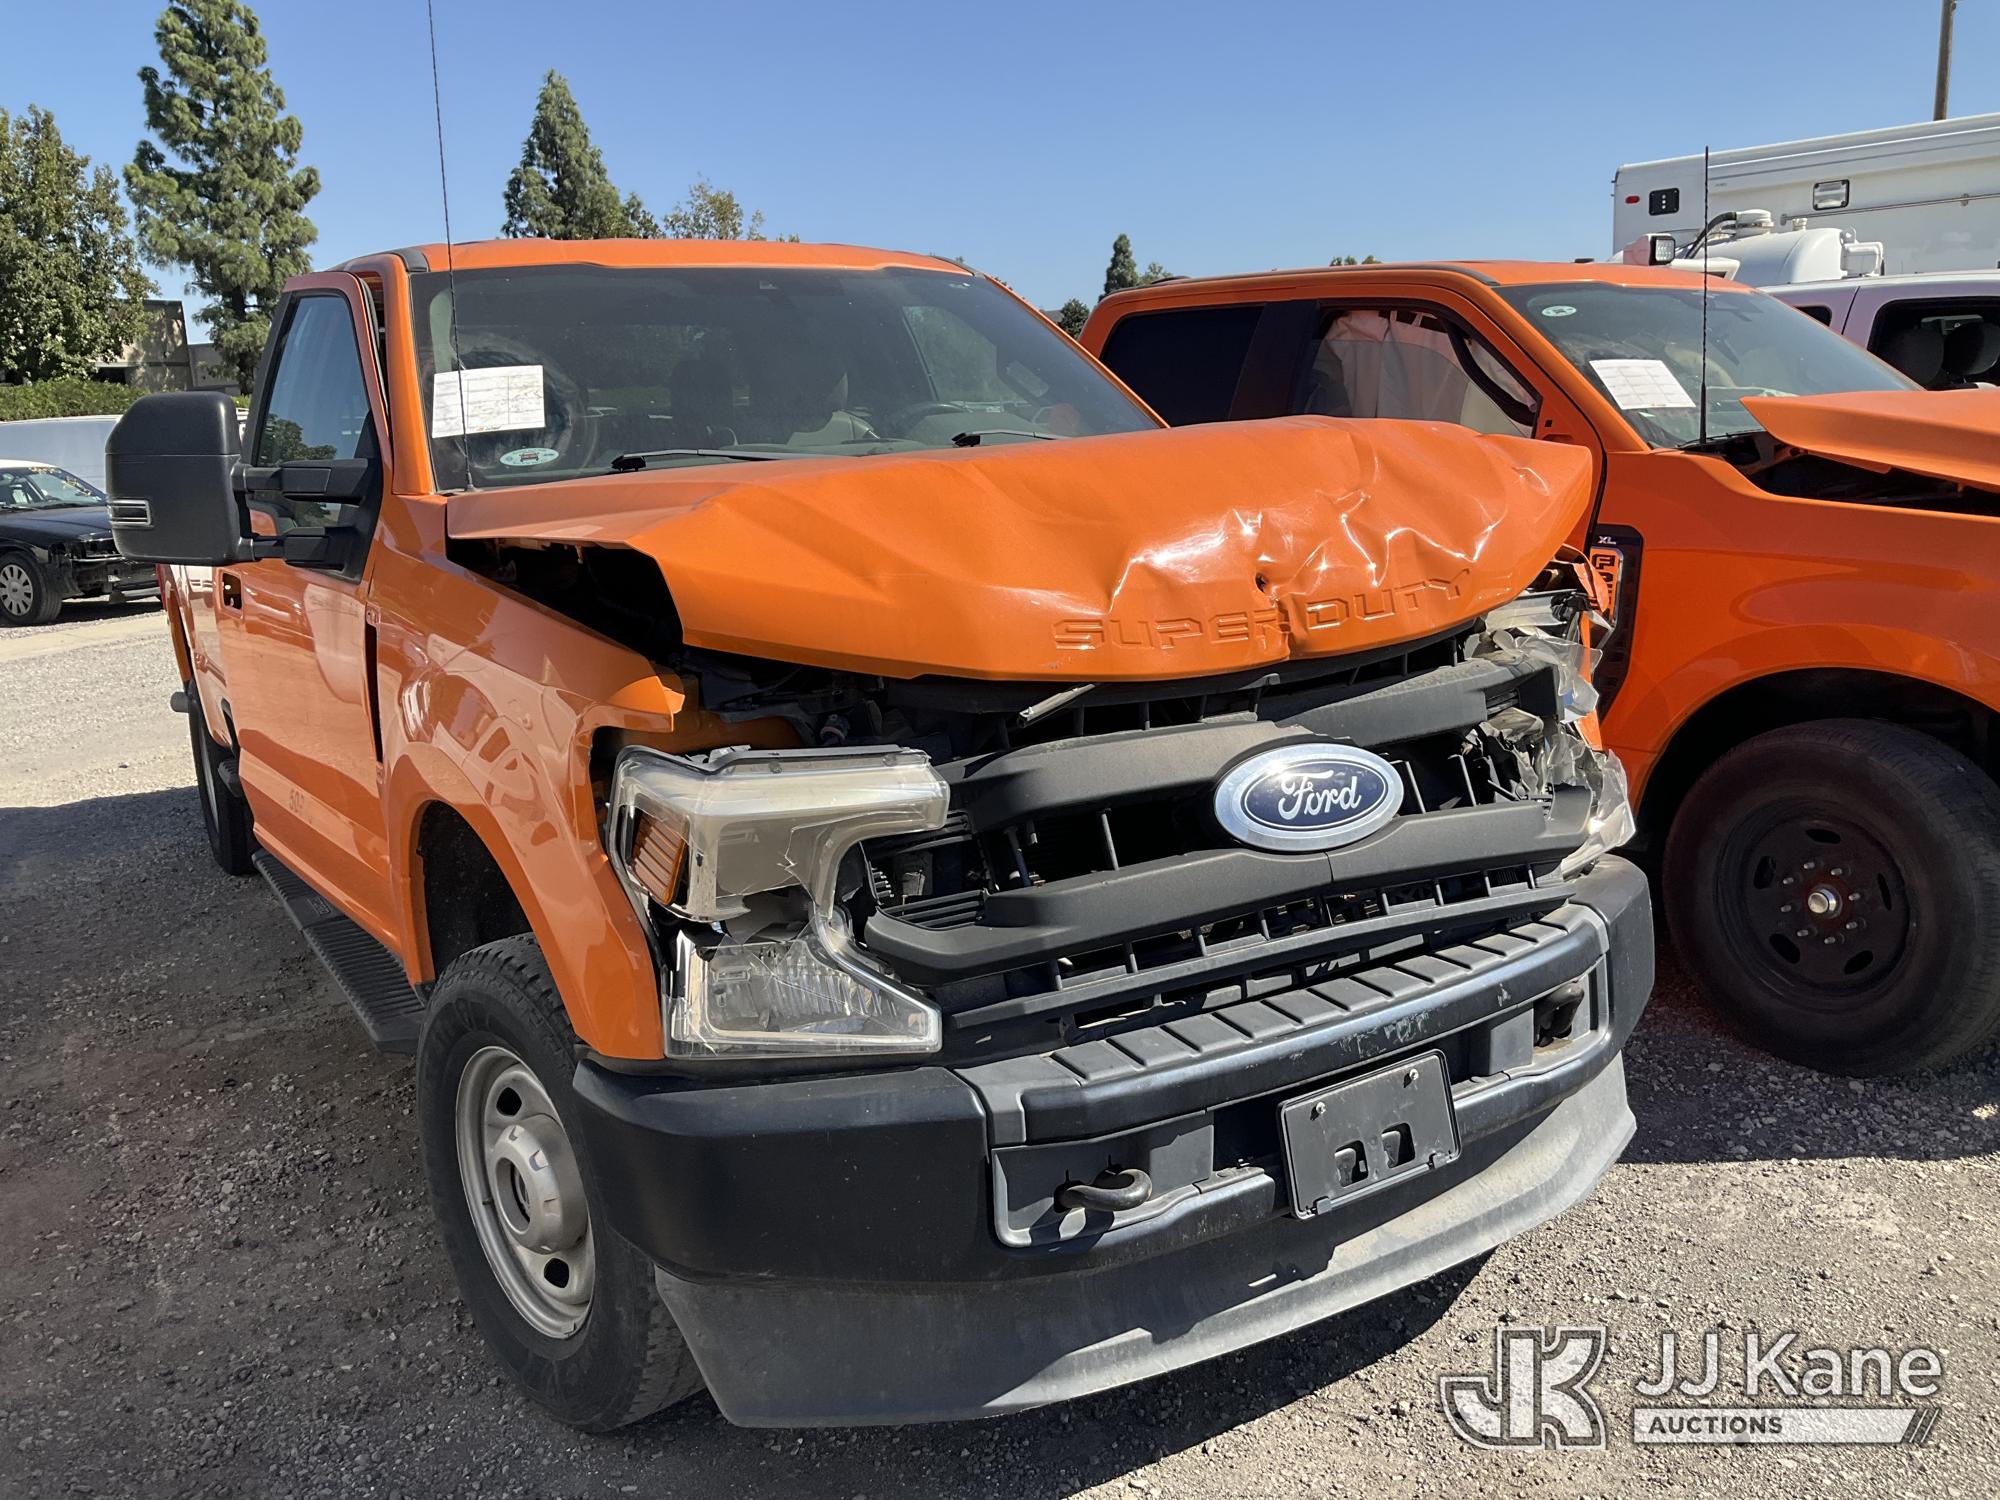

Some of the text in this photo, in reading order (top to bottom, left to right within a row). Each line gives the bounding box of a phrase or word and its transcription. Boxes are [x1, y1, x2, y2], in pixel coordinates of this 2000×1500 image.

[1598, 535, 1617, 545] XL
[1053, 569, 1471, 651] SUPER DUTY
[1278, 769, 1362, 820] Ford
